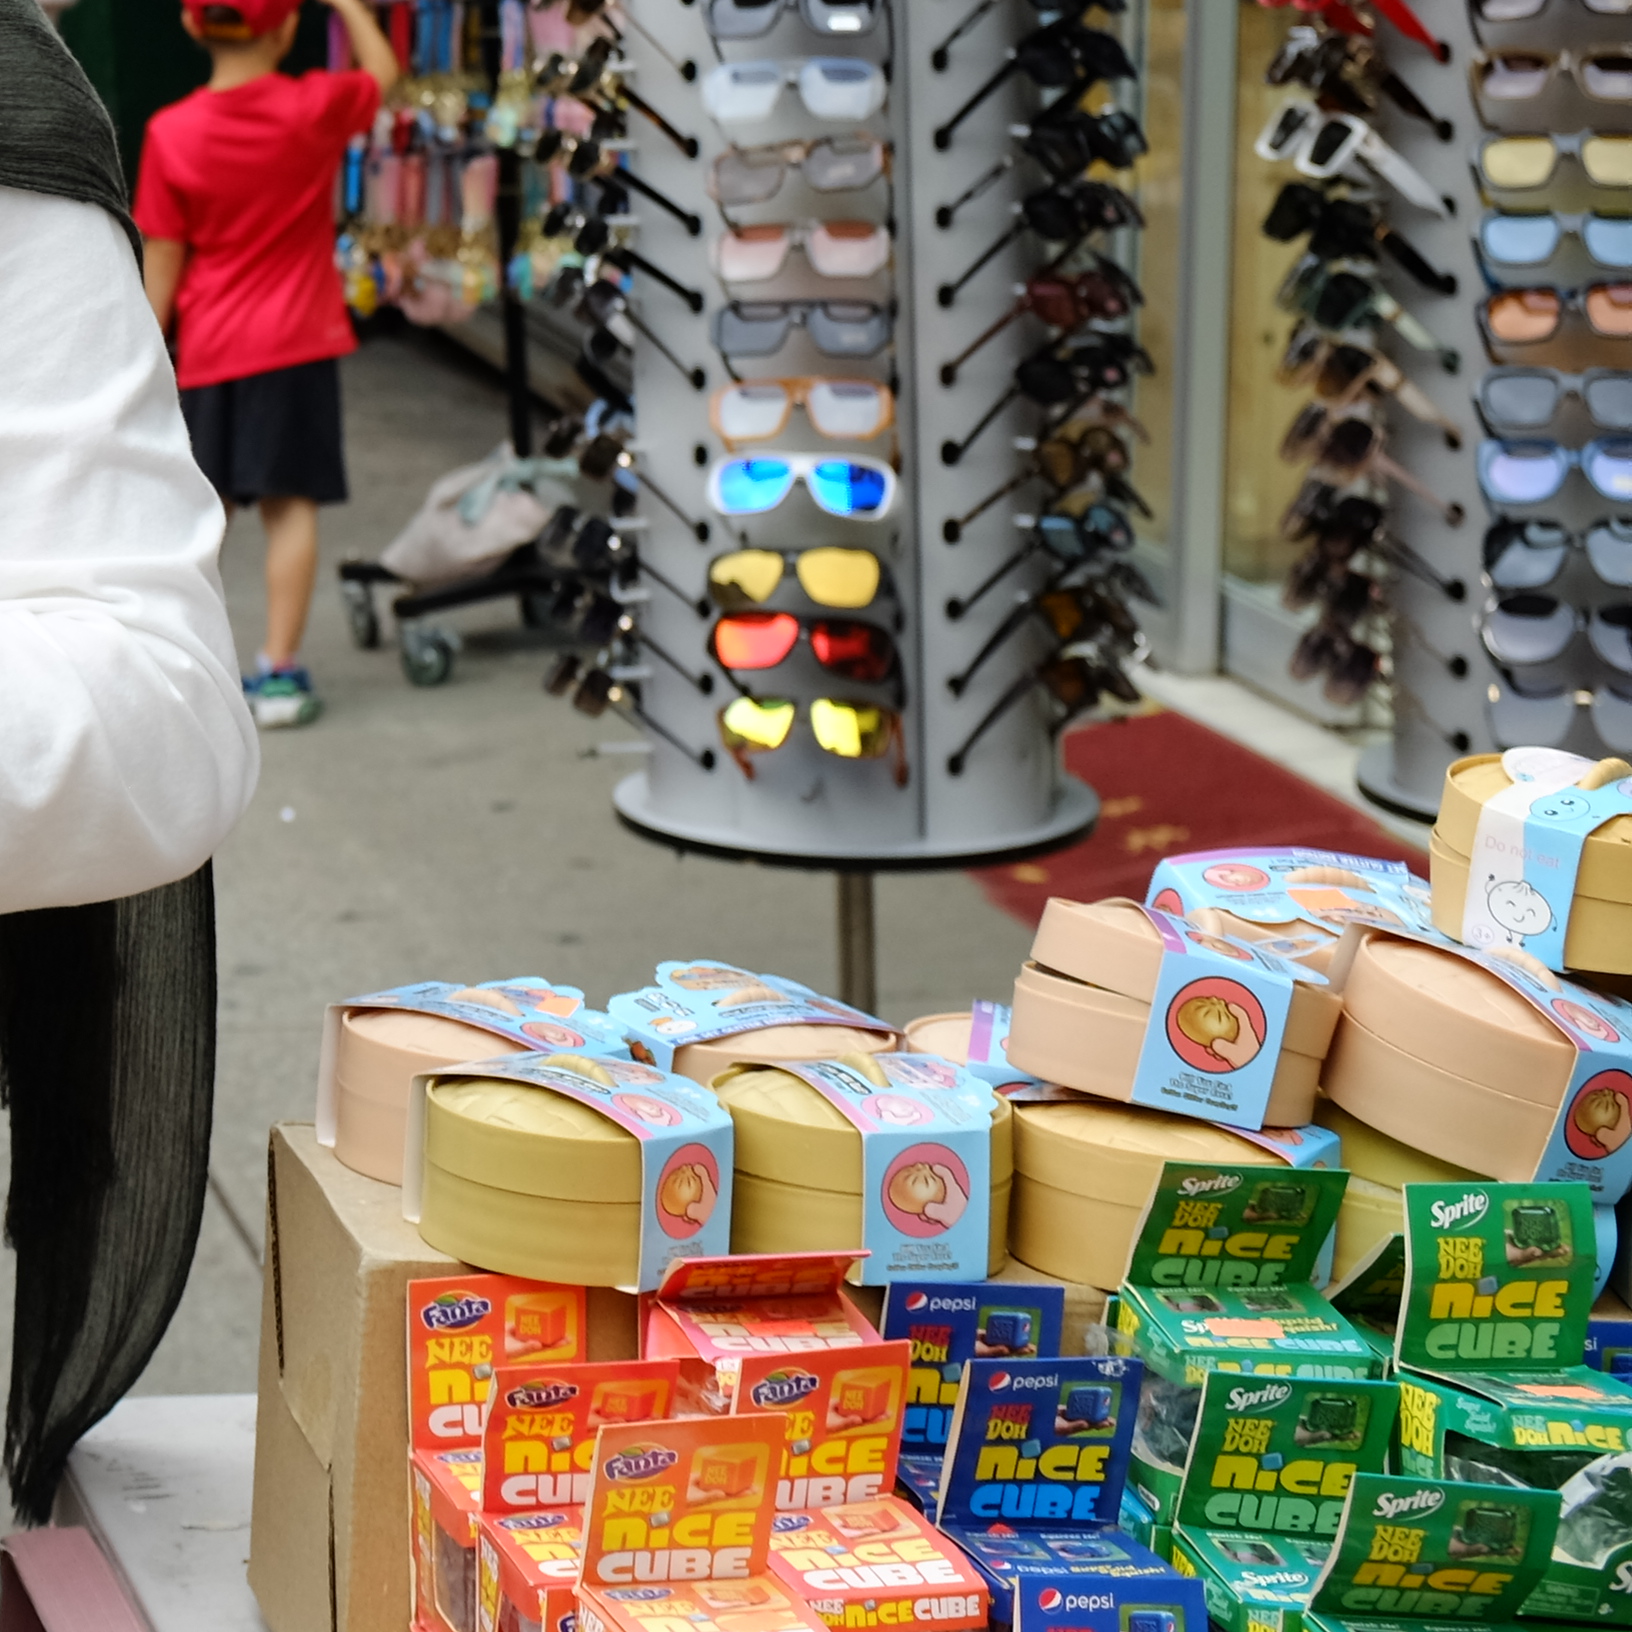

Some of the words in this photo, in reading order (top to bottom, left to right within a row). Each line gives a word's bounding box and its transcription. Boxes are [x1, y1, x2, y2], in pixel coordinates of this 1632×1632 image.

[1484, 835, 1506, 852] Do
[1510, 845, 1533, 861] not
[1537, 853, 1561, 870] eat
[1177, 1173, 1240, 1196] Sprite
[1430, 1191, 1486, 1229] Sprite
[1437, 1237, 1484, 1260] NEE
[1151, 1258, 1286, 1287] CUBE
[1438, 1255, 1483, 1280] DOH
[423, 1296, 491, 1329] Fanta
[930, 1297, 976, 1312] pepsi
[425, 1334, 493, 1368] NEE
[911, 1340, 948, 1363] DOH
[1425, 1322, 1561, 1359] CUBE
[505, 1384, 579, 1410] Fanta
[752, 1373, 818, 1408] Fanta
[1013, 1374, 1059, 1391] pepsi
[1225, 1381, 1289, 1413] Sprite
[990, 1404, 1032, 1424] NEE
[1400, 1381, 1440, 1431] NEE
[502, 1412, 576, 1440] NEE
[785, 1410, 815, 1441] EE
[986, 1420, 1028, 1440] DOH
[1226, 1418, 1276, 1440] NEE
[1400, 1409, 1435, 1458] DOH
[1514, 1428, 1548, 1445] DOH
[1223, 1434, 1269, 1454] DOH
[606, 1449, 678, 1482] Fanta
[602, 1485, 677, 1517] NEE
[774, 1473, 884, 1513] UBE
[969, 1483, 1101, 1520] CUBE
[1372, 1489, 1441, 1519] Sprite
[1204, 1492, 1346, 1536] CUBE
[1374, 1525, 1427, 1548] NEE
[597, 1547, 753, 1583] CUBE
[1368, 1542, 1420, 1564] DOH
[803, 1559, 966, 1591] CUBE
[1240, 1571, 1305, 1587] Sprite
[914, 1595, 981, 1620] CUBE
[1066, 1593, 1115, 1612] pepsi
[1341, 1586, 1495, 1617] CUBE
